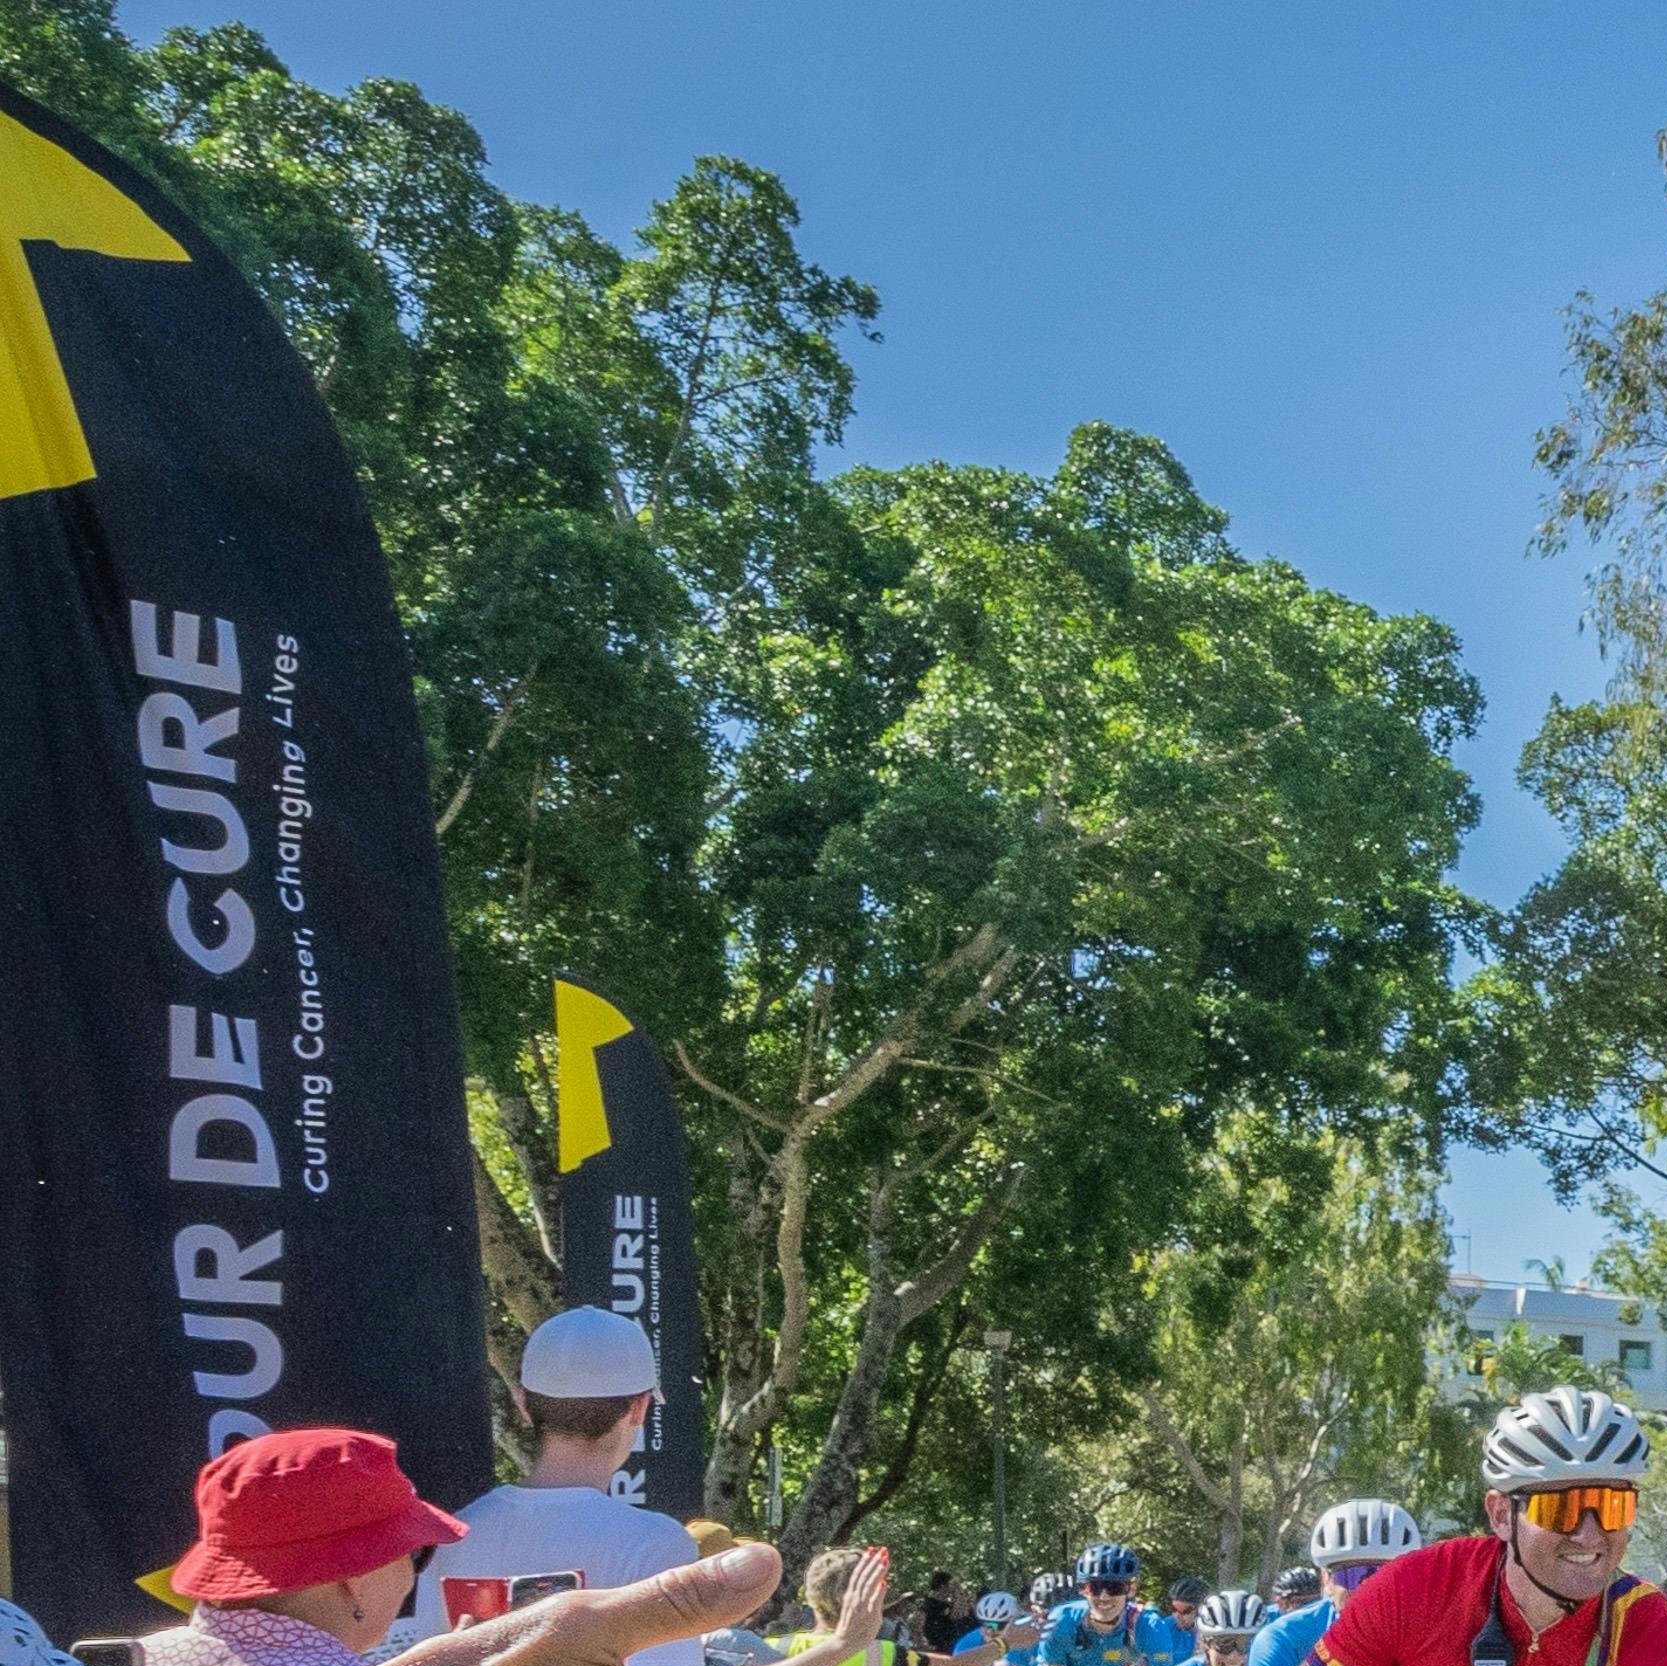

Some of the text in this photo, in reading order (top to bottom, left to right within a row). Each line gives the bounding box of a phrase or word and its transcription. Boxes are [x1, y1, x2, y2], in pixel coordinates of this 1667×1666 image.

[130, 599, 284, 1460] OUR DE CURE
[265, 633, 334, 1194] Curing Cancer, Changing Lives
[611, 1194, 646, 1318] URE
